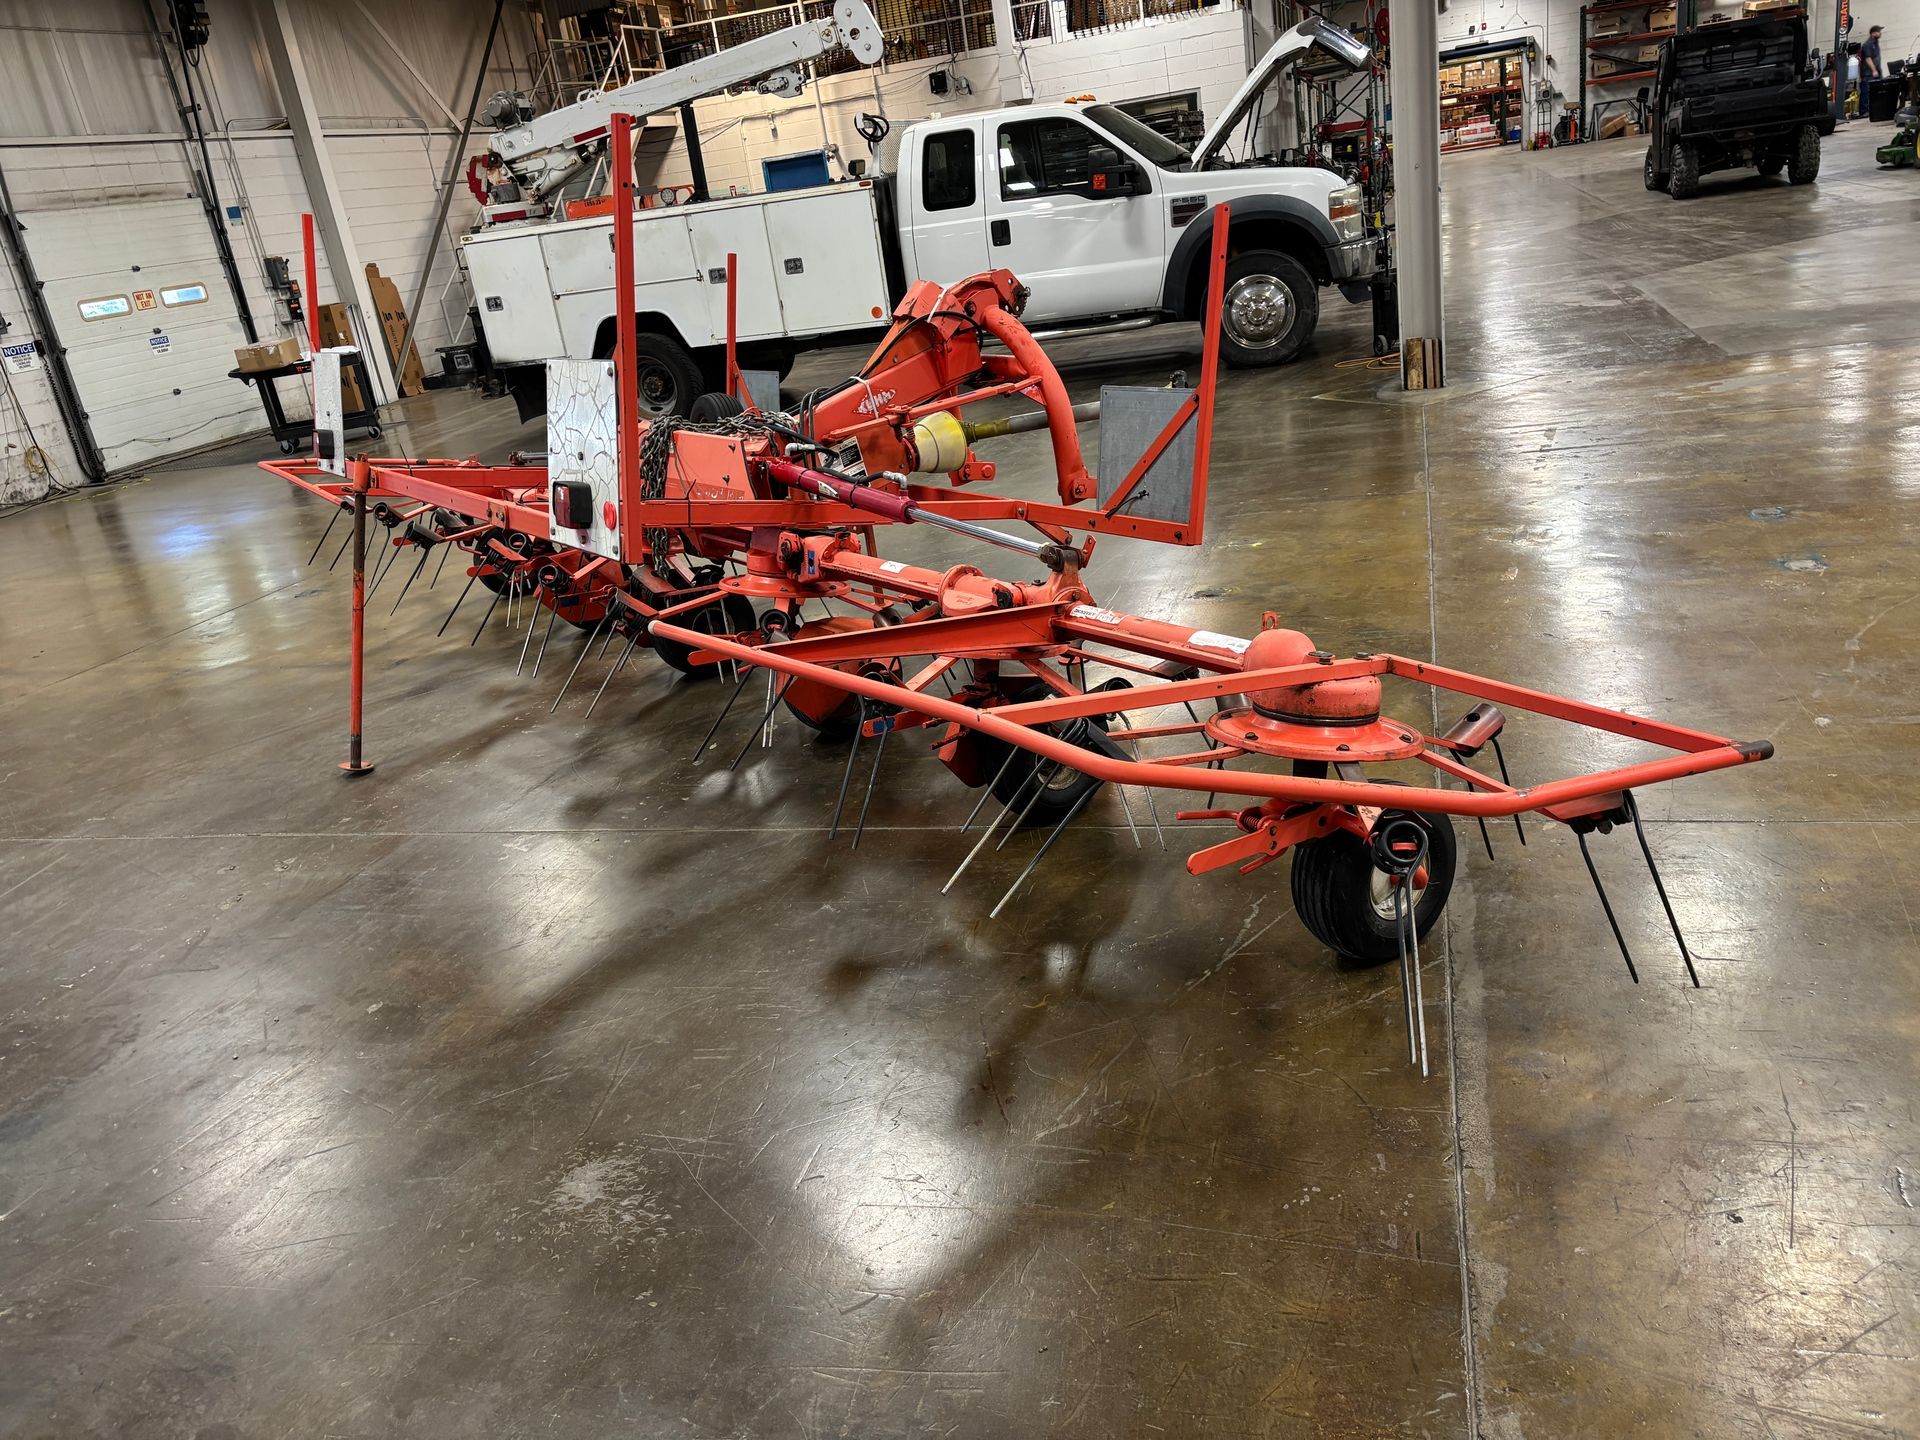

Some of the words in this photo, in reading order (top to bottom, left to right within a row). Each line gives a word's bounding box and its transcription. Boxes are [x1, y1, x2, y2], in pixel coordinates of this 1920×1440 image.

[135, 293, 145, 301] NOT
[140, 300, 151, 308] EXIT
[3, 344, 34, 356] NOTICE
